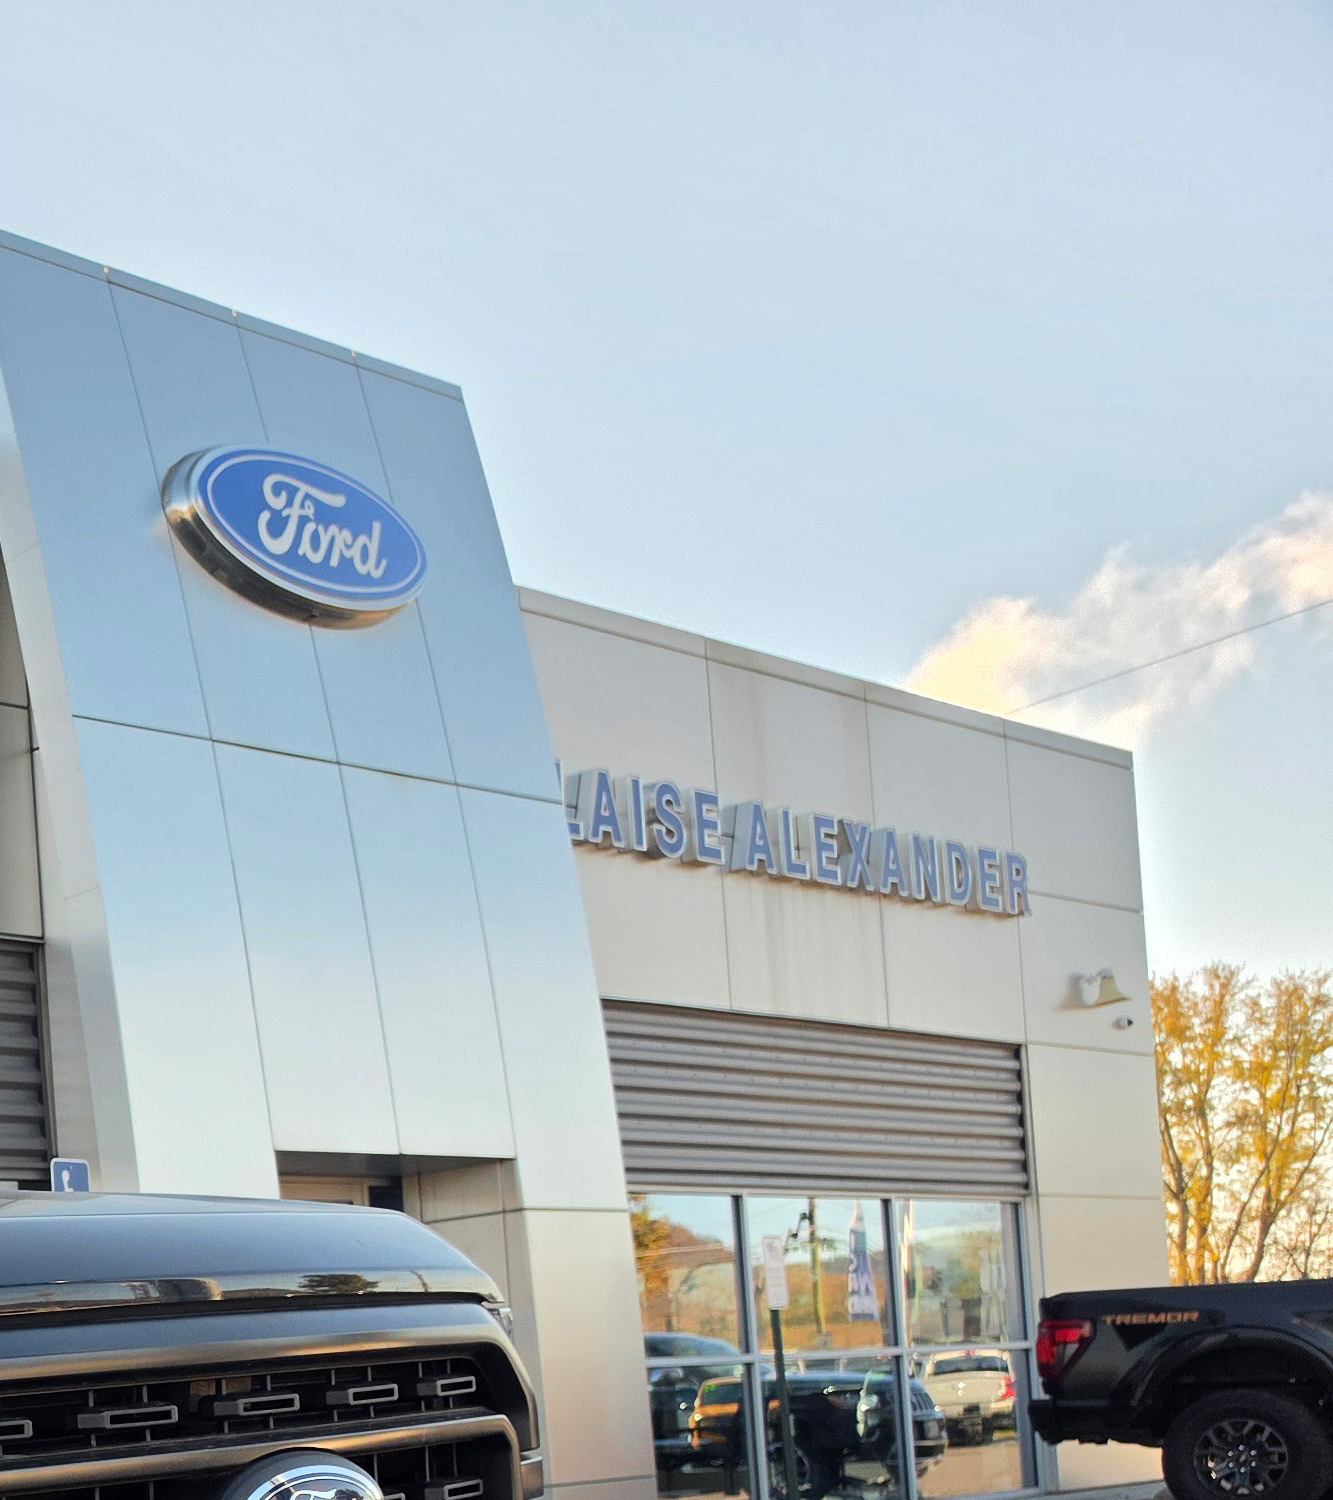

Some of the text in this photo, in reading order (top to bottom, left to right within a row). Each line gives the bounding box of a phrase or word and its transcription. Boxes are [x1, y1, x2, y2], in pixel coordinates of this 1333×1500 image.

[257, 473, 387, 579] Ford
[745, 800, 1032, 917] ALEXANDER
[1100, 1310, 1200, 1326] TREMOR
